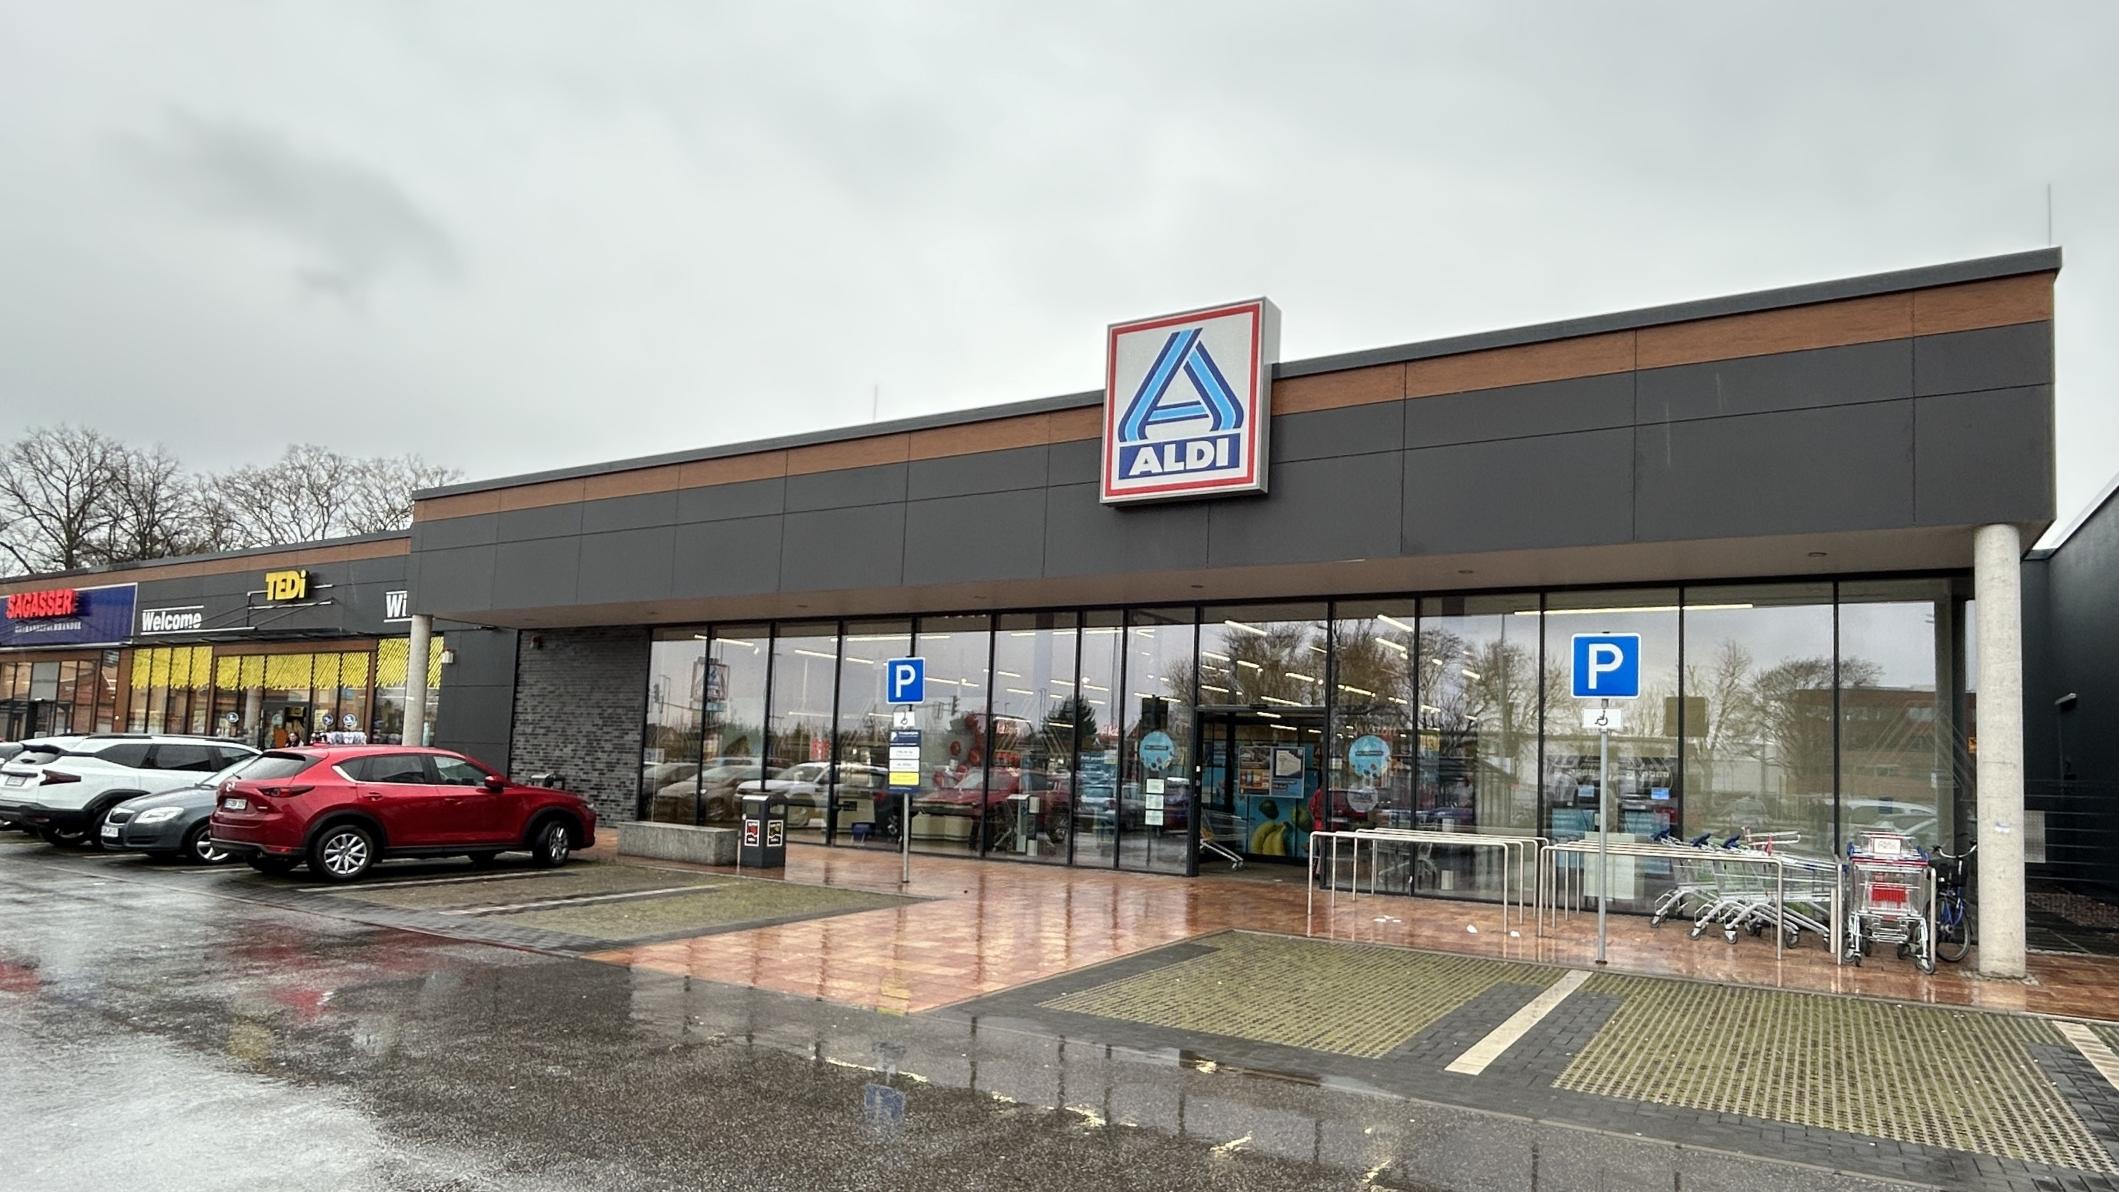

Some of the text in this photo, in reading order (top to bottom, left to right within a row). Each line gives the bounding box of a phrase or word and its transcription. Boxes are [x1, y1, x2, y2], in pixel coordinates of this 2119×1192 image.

[1128, 438, 1229, 476] ALDI
[265, 569, 306, 601] TEDi
[6, 588, 75, 619] SAGASSER
[141, 611, 201, 632] Welcome
[895, 664, 916, 698] P
[1587, 643, 1624, 690] P
